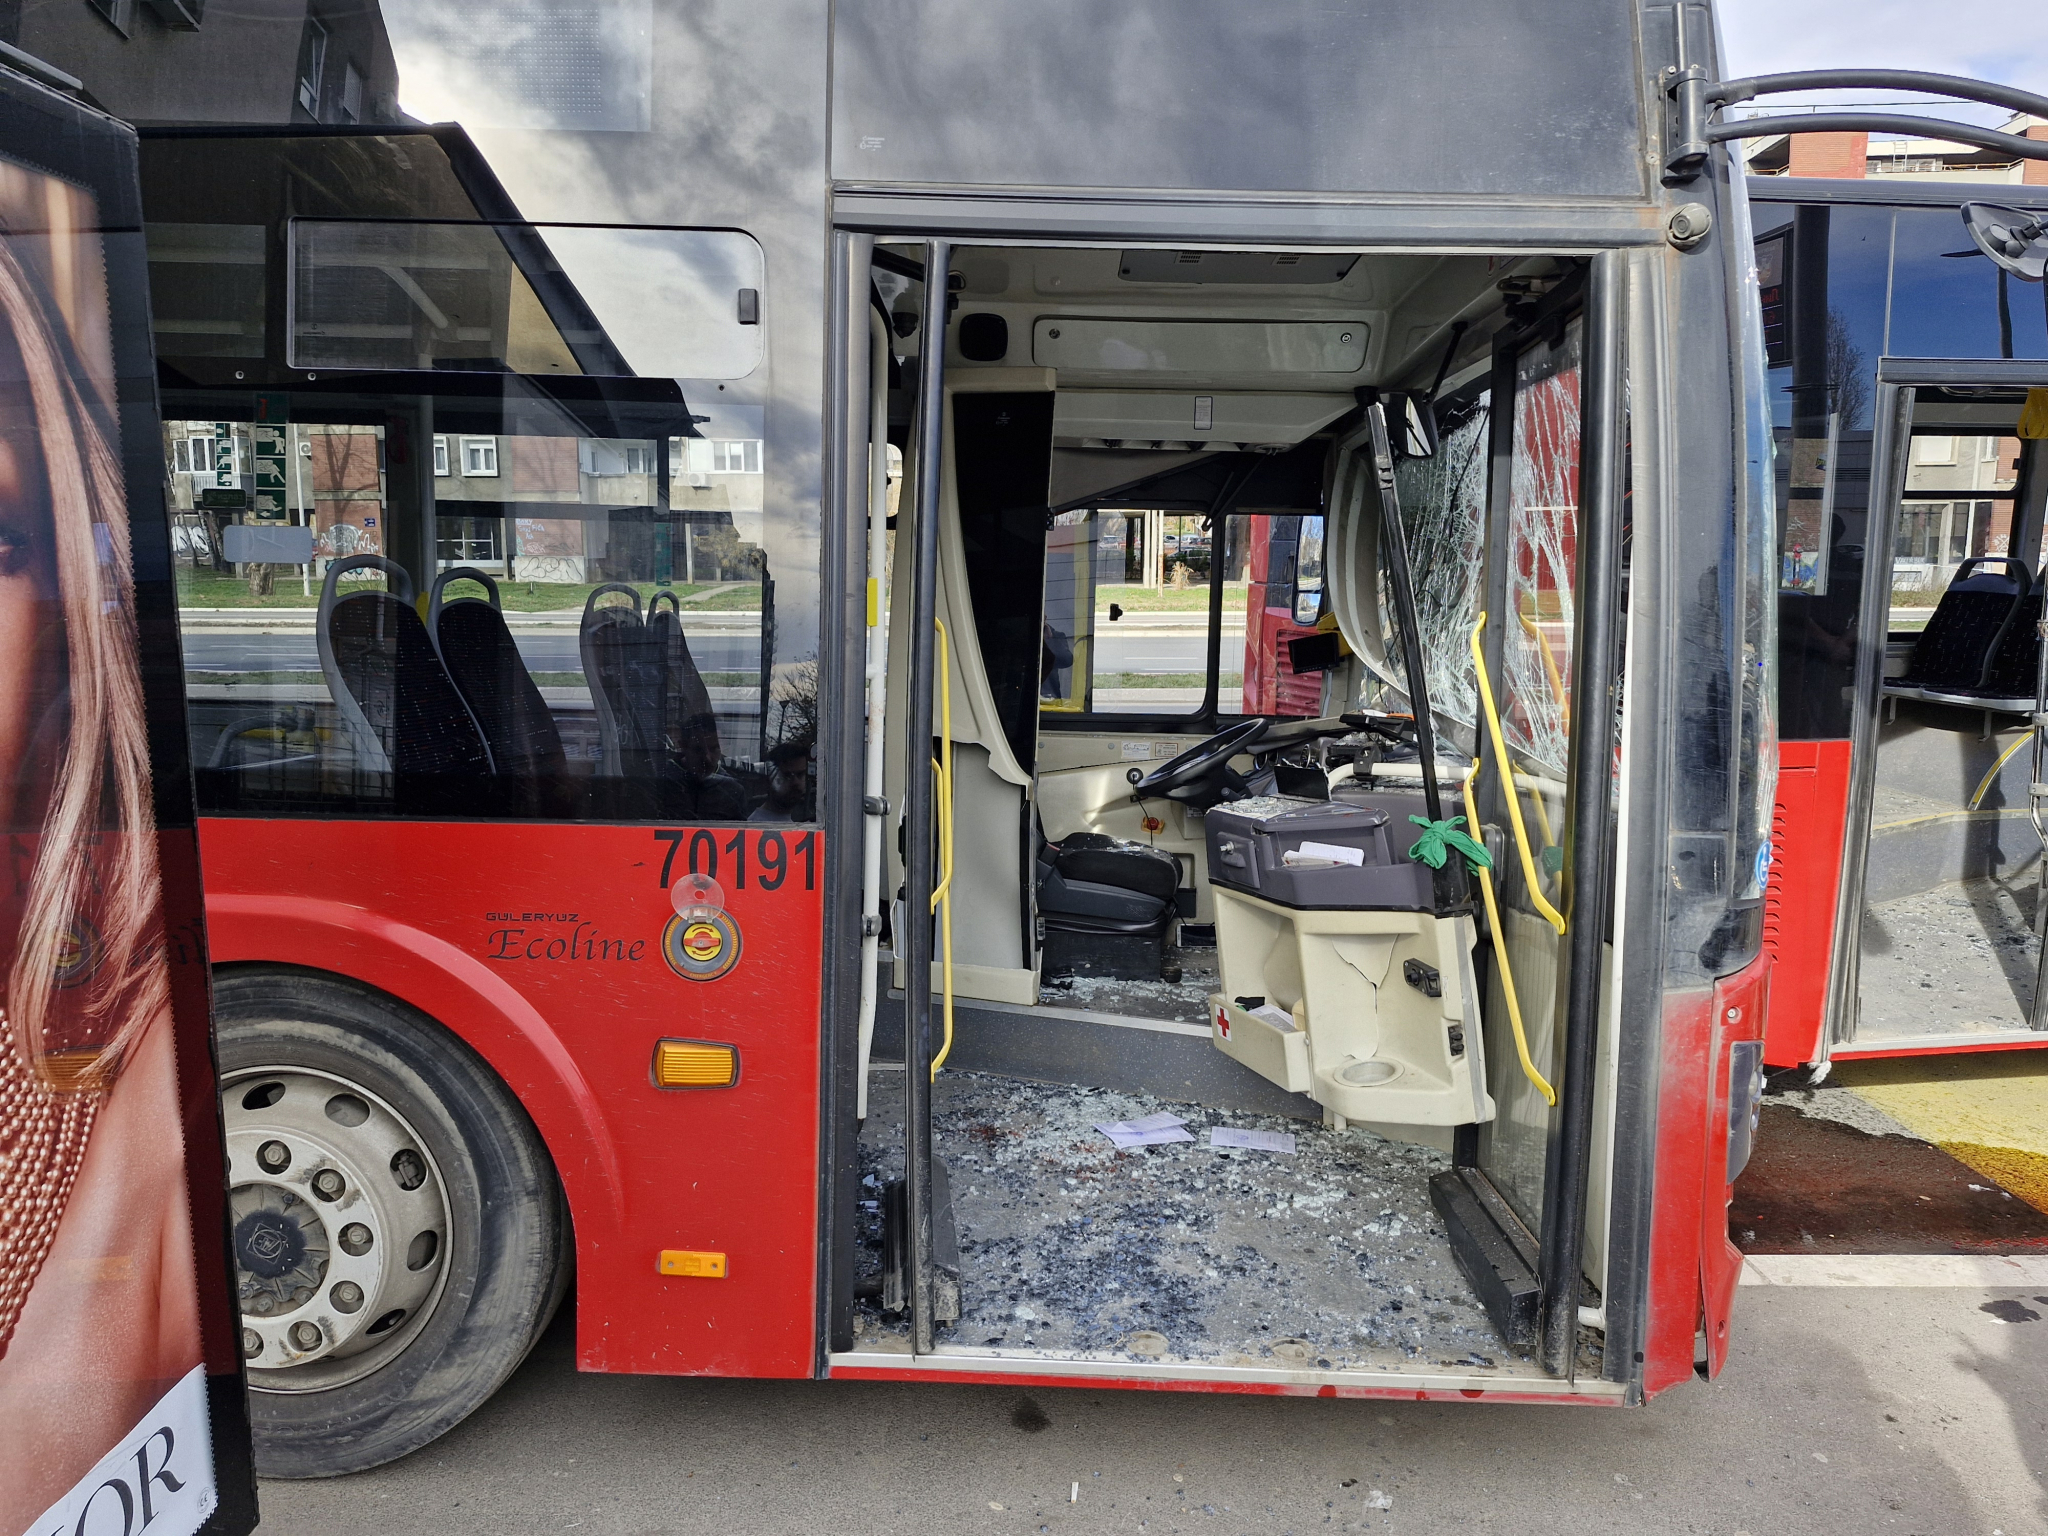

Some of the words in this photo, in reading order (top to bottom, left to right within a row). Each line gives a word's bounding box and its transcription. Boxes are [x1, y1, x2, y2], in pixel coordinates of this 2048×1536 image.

[653, 829, 815, 891] 70191
[486, 921, 645, 961] Ecoline
[50, 1426, 187, 1536] OR
